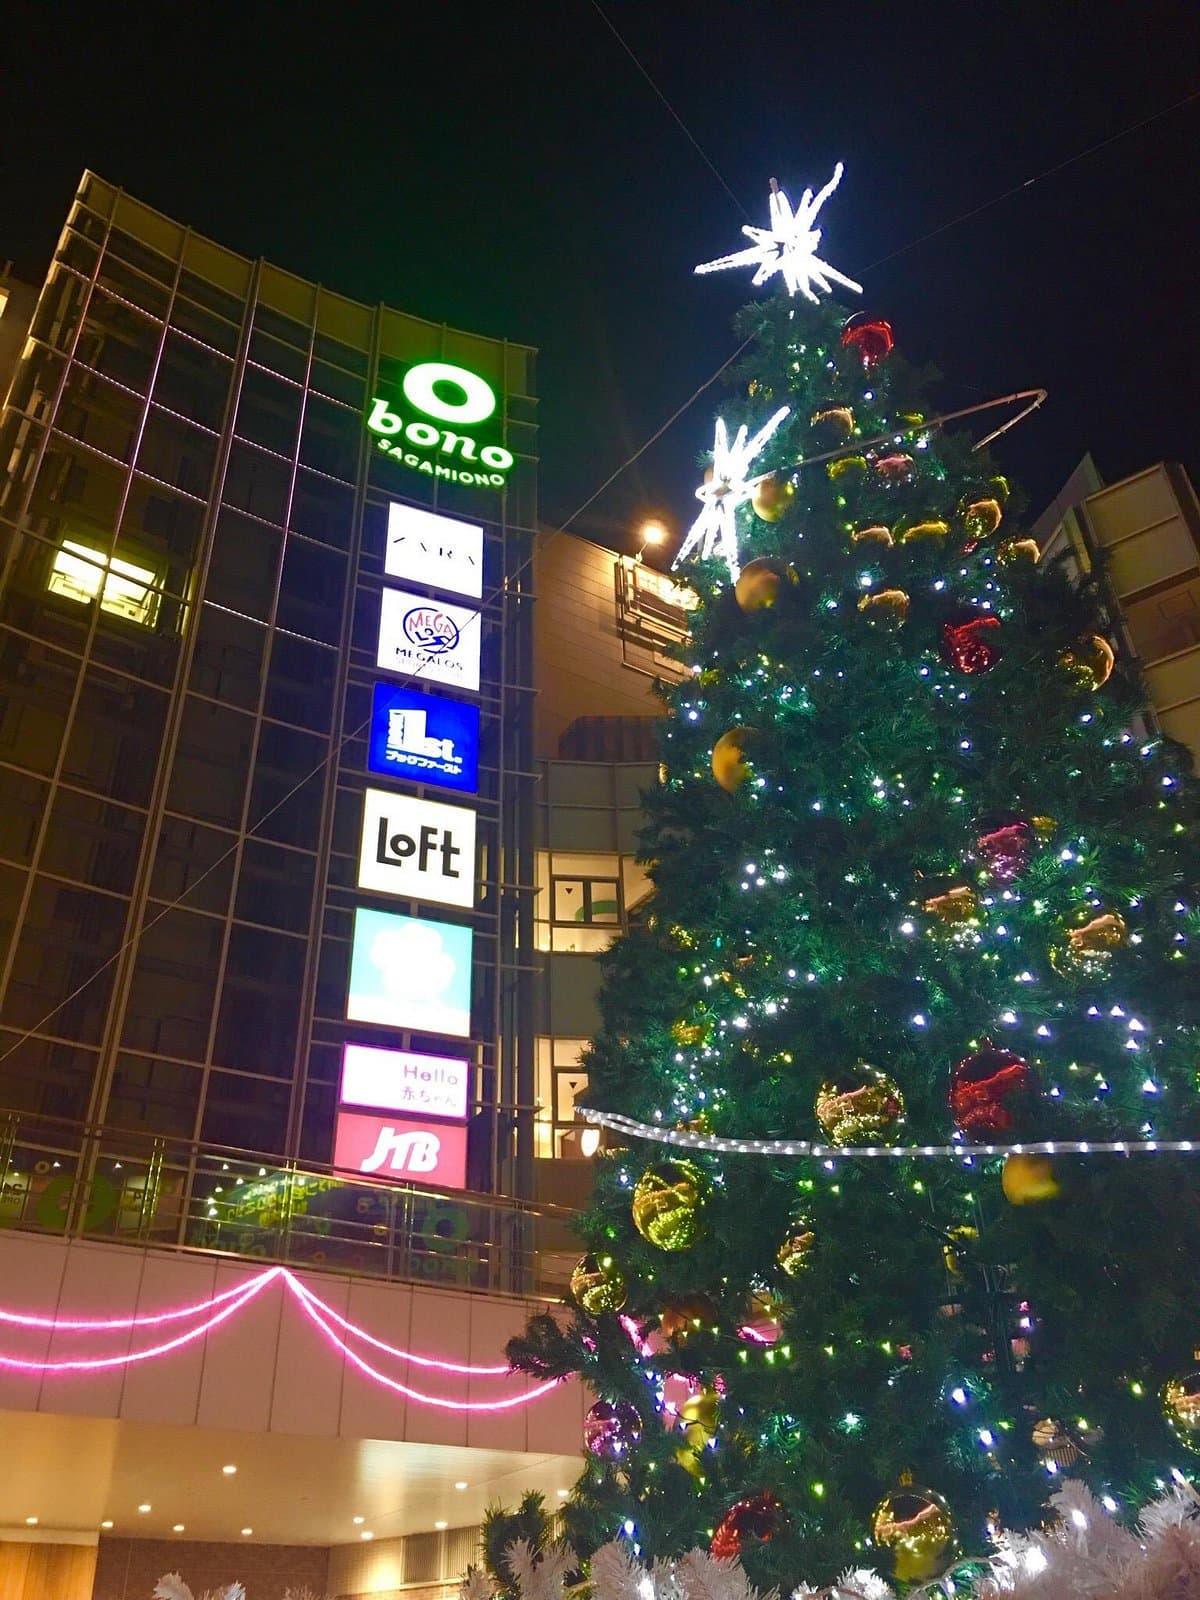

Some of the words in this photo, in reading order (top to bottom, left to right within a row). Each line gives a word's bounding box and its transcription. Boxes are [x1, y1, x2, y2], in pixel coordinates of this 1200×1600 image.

[367, 397, 514, 470] bono
[377, 438, 505, 486] SAGAMIONO
[409, 611, 454, 637] MEGA
[403, 1064, 459, 1086] Hello
[359, 1126, 441, 1173] JTB
